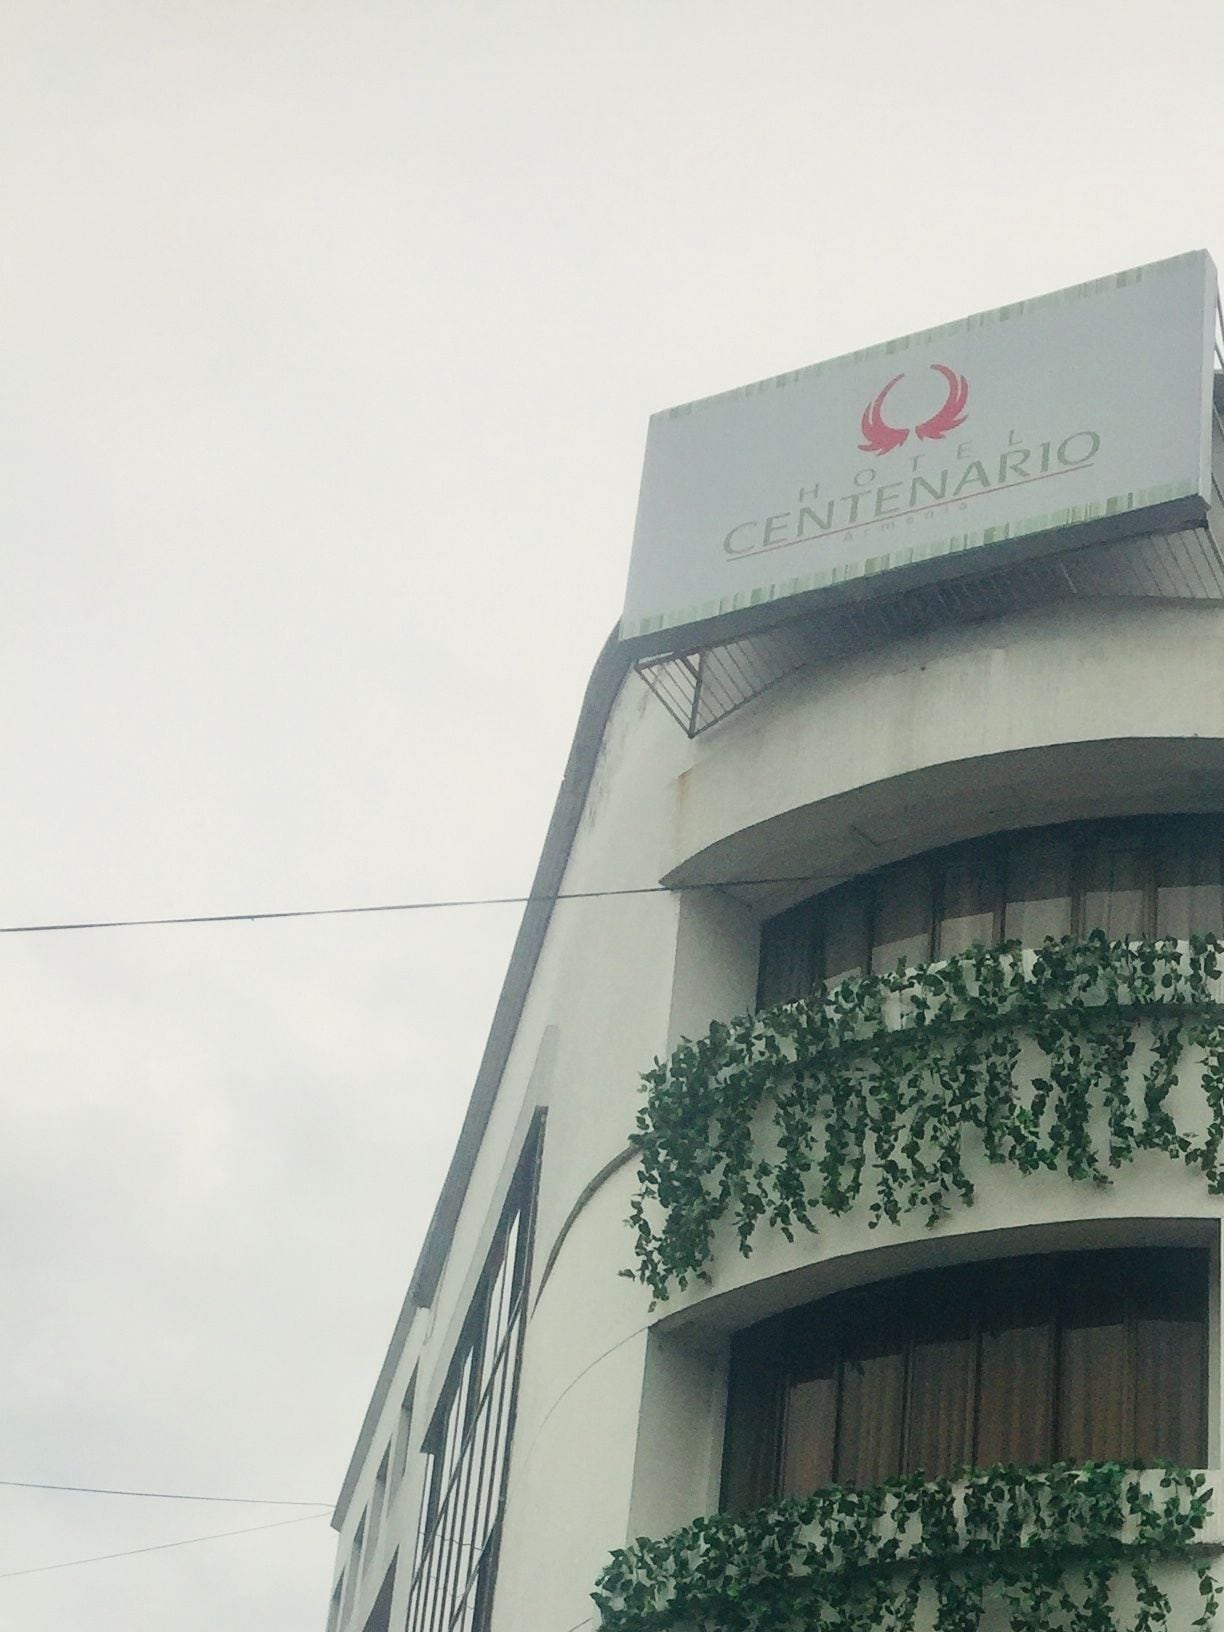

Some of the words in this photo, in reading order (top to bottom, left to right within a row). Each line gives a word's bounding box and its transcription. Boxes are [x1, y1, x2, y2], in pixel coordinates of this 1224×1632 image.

[723, 431, 1101, 554] CENTENARIO
[799, 430, 1021, 500] HOTEL
[843, 502, 968, 543] Armenia
